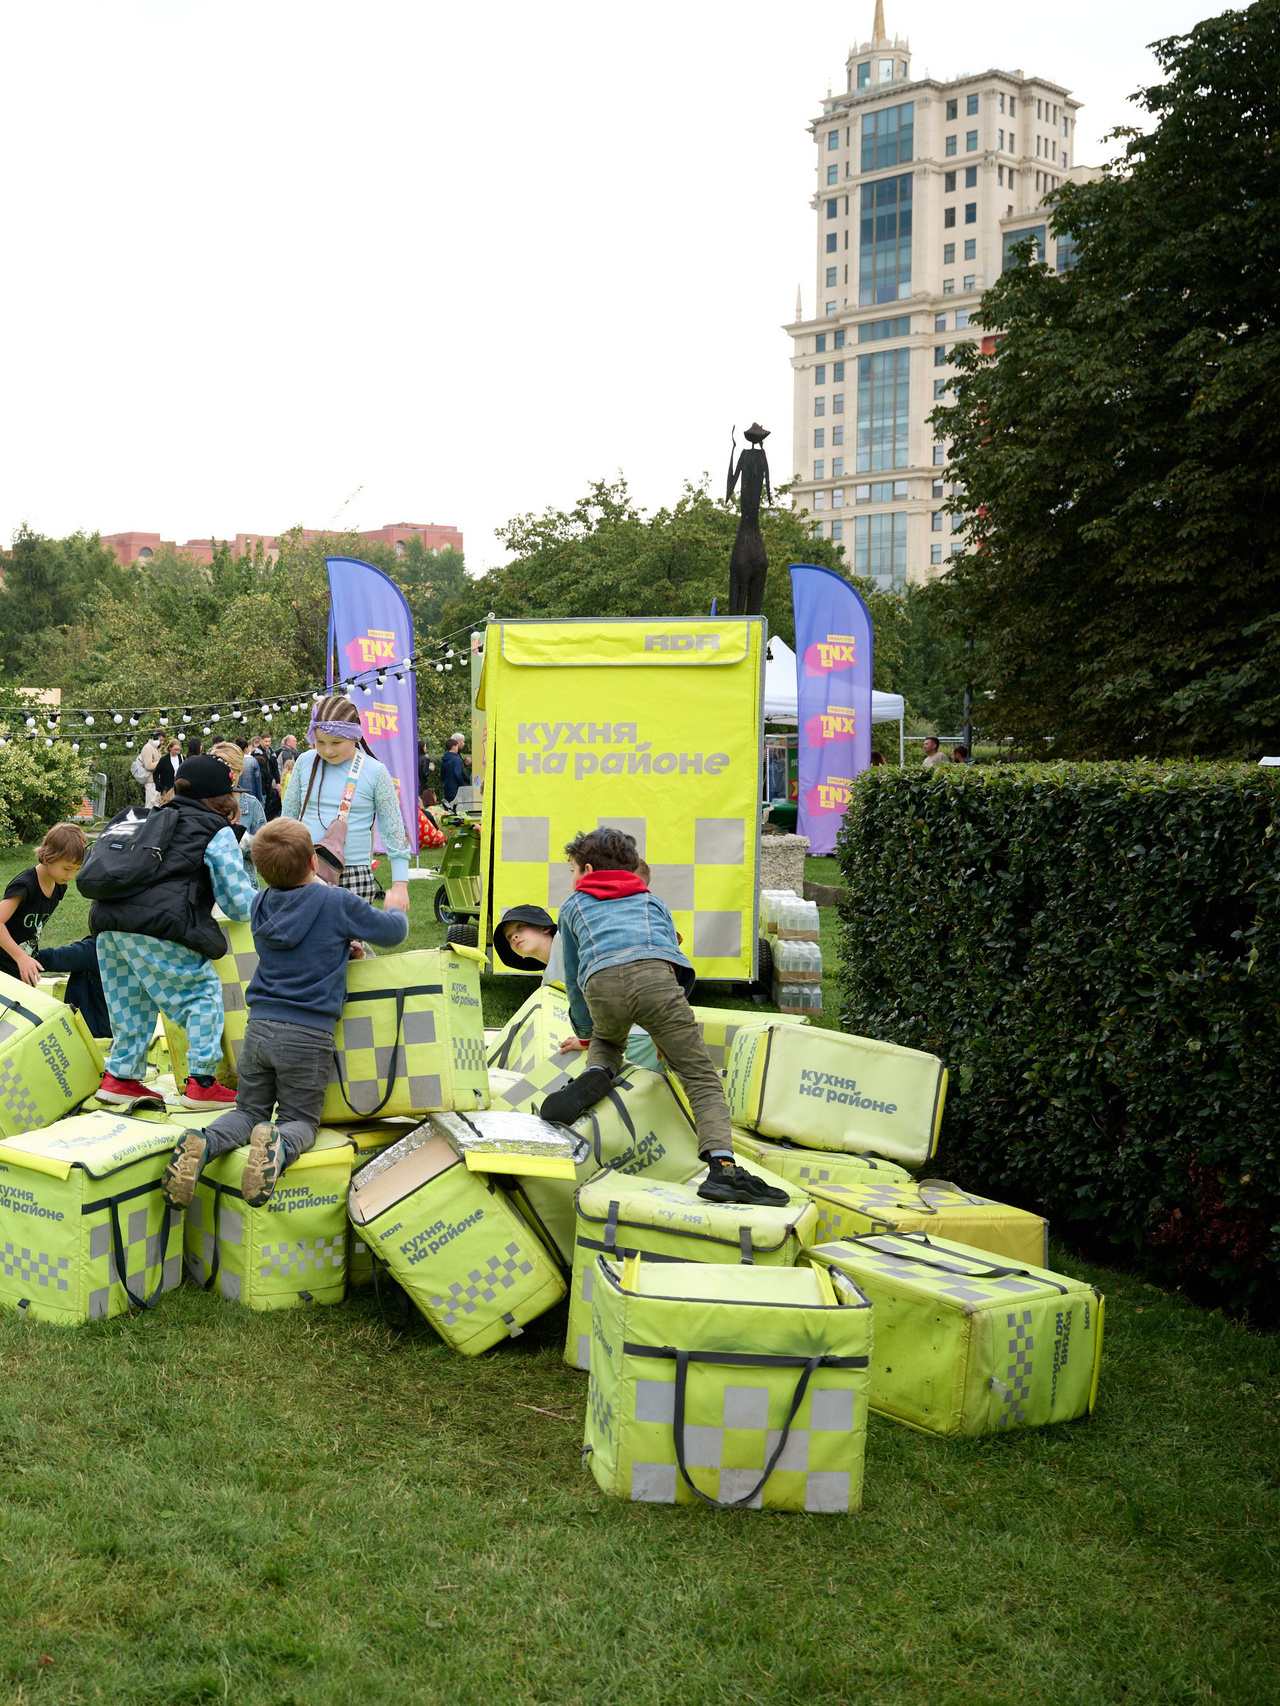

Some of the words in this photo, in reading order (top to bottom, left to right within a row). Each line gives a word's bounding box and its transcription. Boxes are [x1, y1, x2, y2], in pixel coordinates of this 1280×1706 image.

[644, 634, 720, 651] RDR
[518, 722, 637, 752] кухня
[518, 752, 568, 774] на
[574, 742, 730, 780] районе
[60, 1017, 72, 1036] RDR
[47, 1032, 70, 1069] кухня
[38, 1039, 52, 1056] на
[45, 1055, 72, 1098] районе
[801, 1069, 856, 1091] кухня
[799, 1083, 824, 1098] на
[826, 1088, 898, 1114] районе
[624, 1143, 666, 1175] кухн
[268, 1202, 286, 1213] на
[288, 1193, 339, 1212] районе
[270, 1186, 309, 1202] кухня
[13, 1201, 64, 1222] районе
[658, 1209, 702, 1225] куня
[378, 1222, 404, 1241] RDR
[398, 1220, 446, 1256] кухня
[406, 1249, 429, 1266] на
[428, 1208, 484, 1256] районе
[1056, 1312, 1064, 1336] на
[1060, 1310, 1072, 1365] кухня
